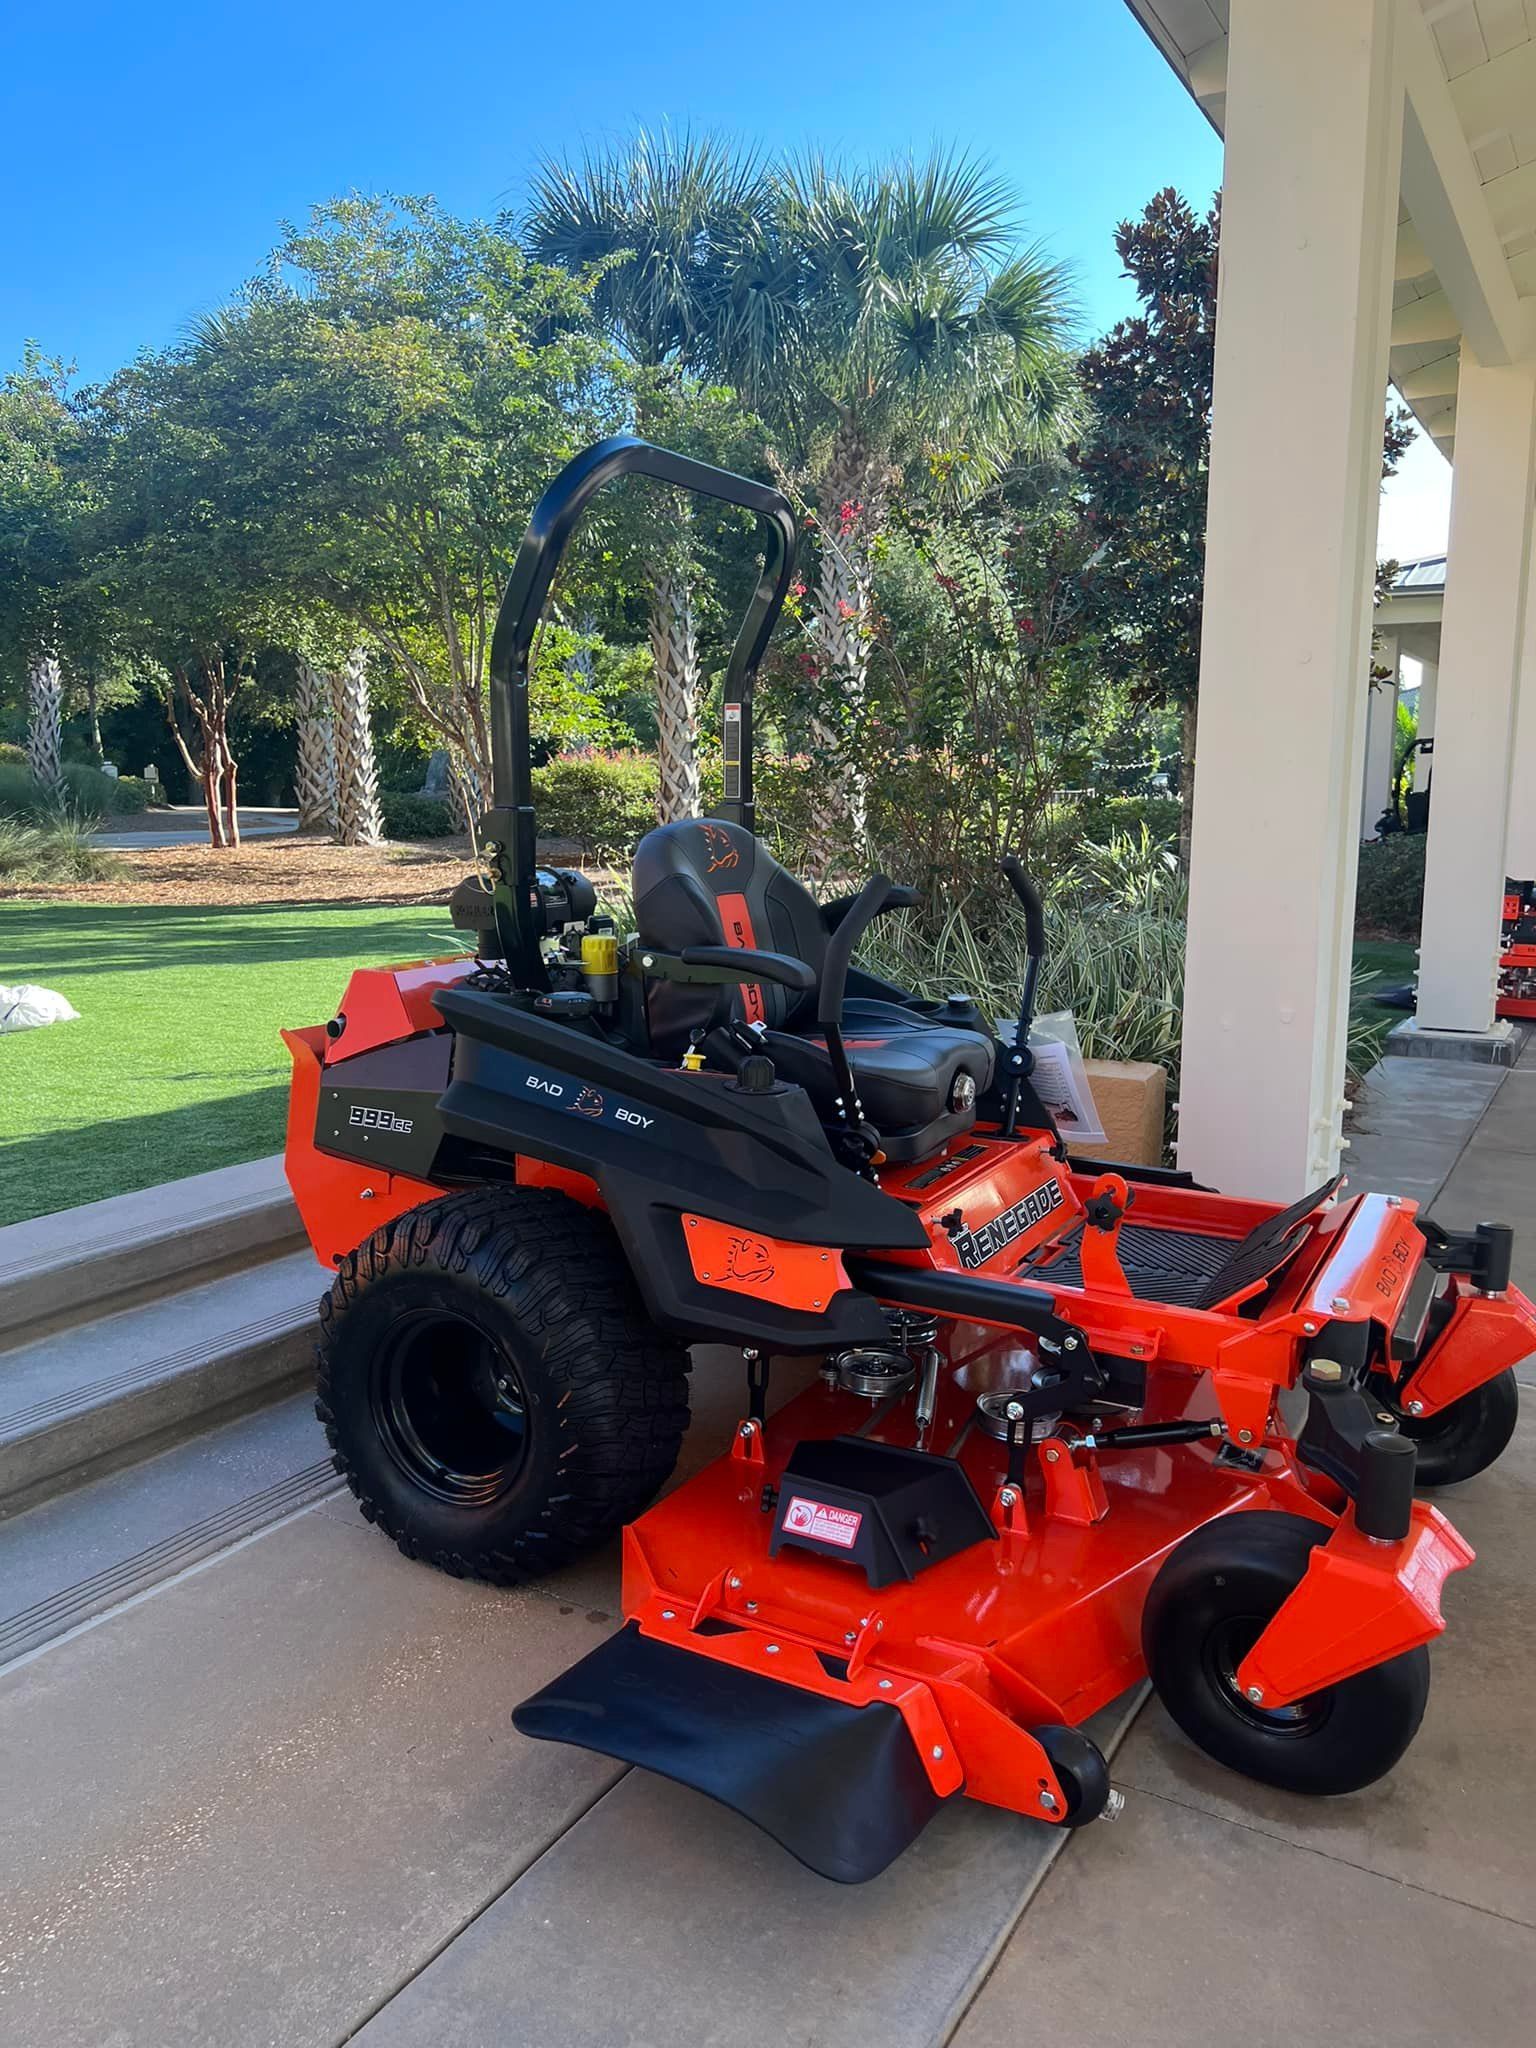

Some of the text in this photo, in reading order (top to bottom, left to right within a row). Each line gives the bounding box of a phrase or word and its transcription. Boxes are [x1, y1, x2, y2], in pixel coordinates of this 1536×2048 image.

[525, 1075, 655, 1130] BAD BOY
[949, 1178, 1064, 1269] RENEGADE
[1376, 1239, 1412, 1297] BAD BOY
[829, 1509, 859, 1527] DANGER
